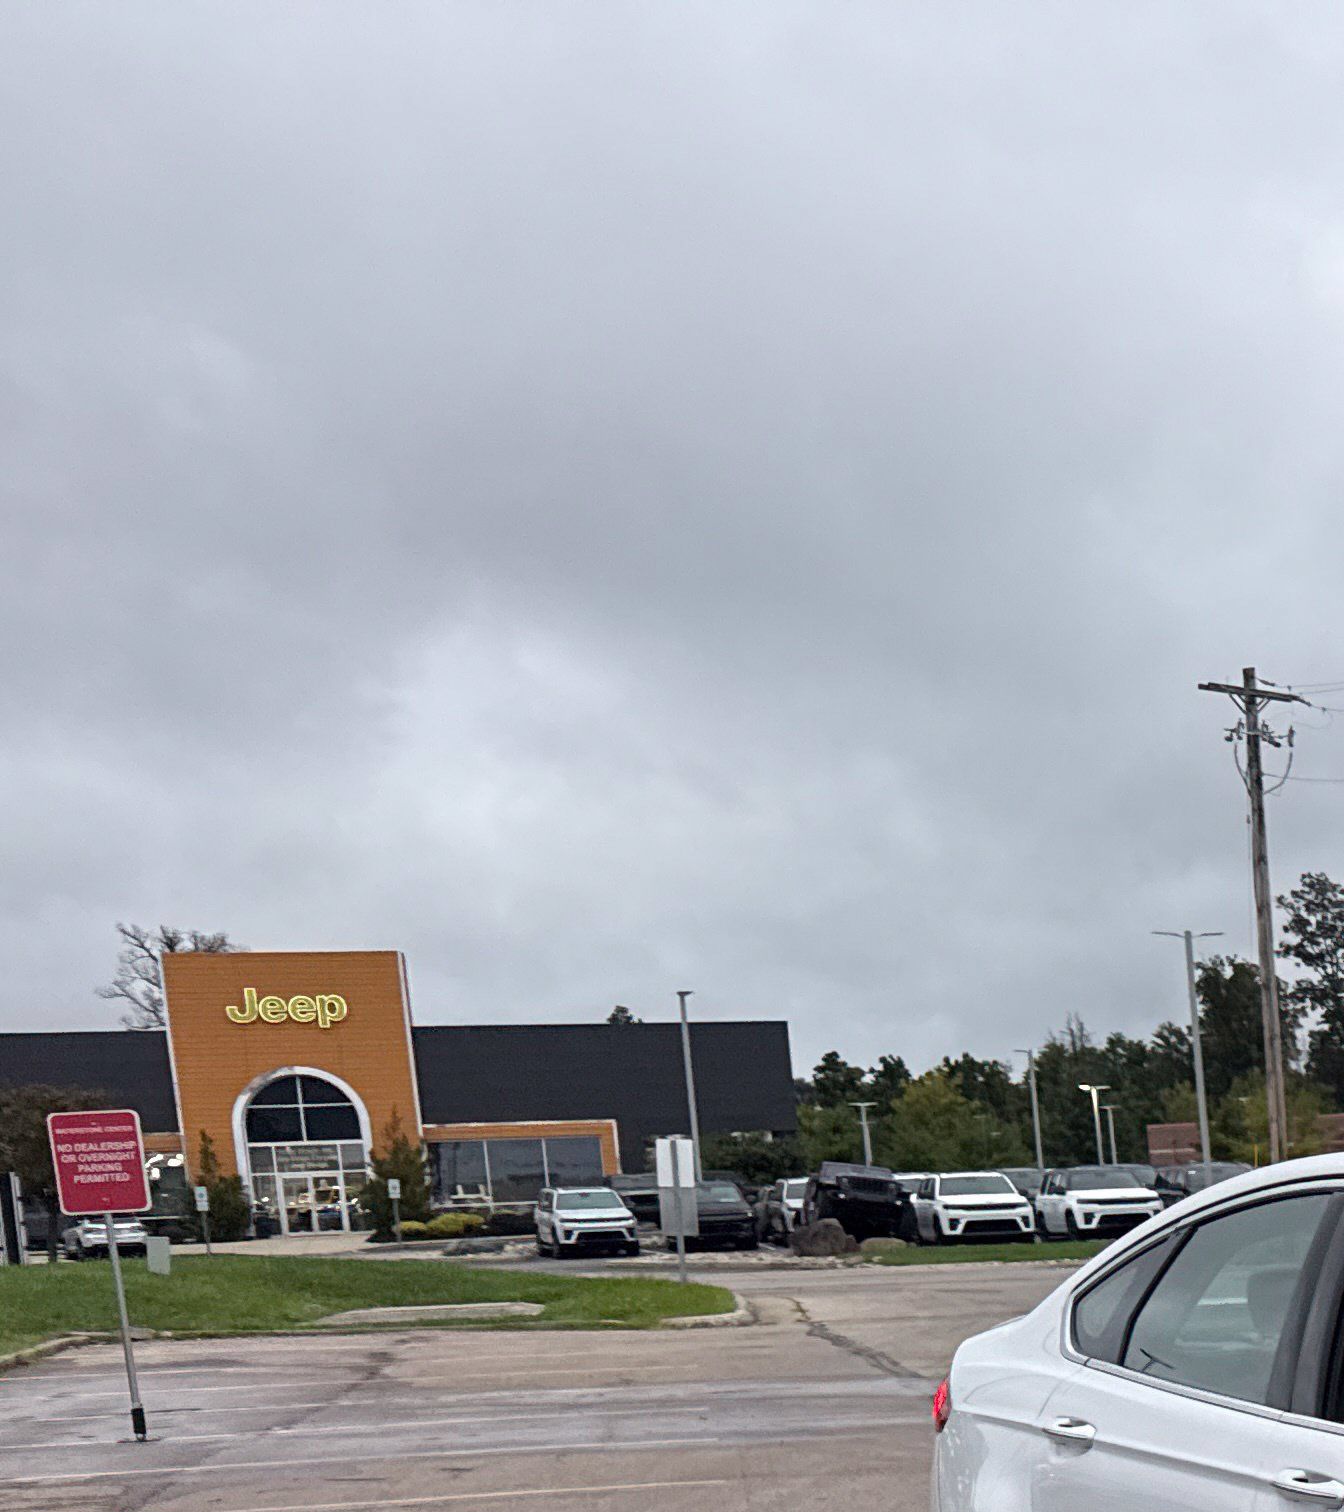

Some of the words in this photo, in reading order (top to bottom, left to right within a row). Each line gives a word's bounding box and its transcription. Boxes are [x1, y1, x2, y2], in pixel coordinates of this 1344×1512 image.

[225, 987, 348, 1029] Jeep
[57, 1144, 72, 1152] NO
[74, 1141, 137, 1151] DEALERSHIP
[61, 1154, 76, 1163] OR
[78, 1152, 135, 1162] OVERNIGHT
[78, 1163, 122, 1172] PARKING
[73, 1173, 130, 1183] PERMITTED
